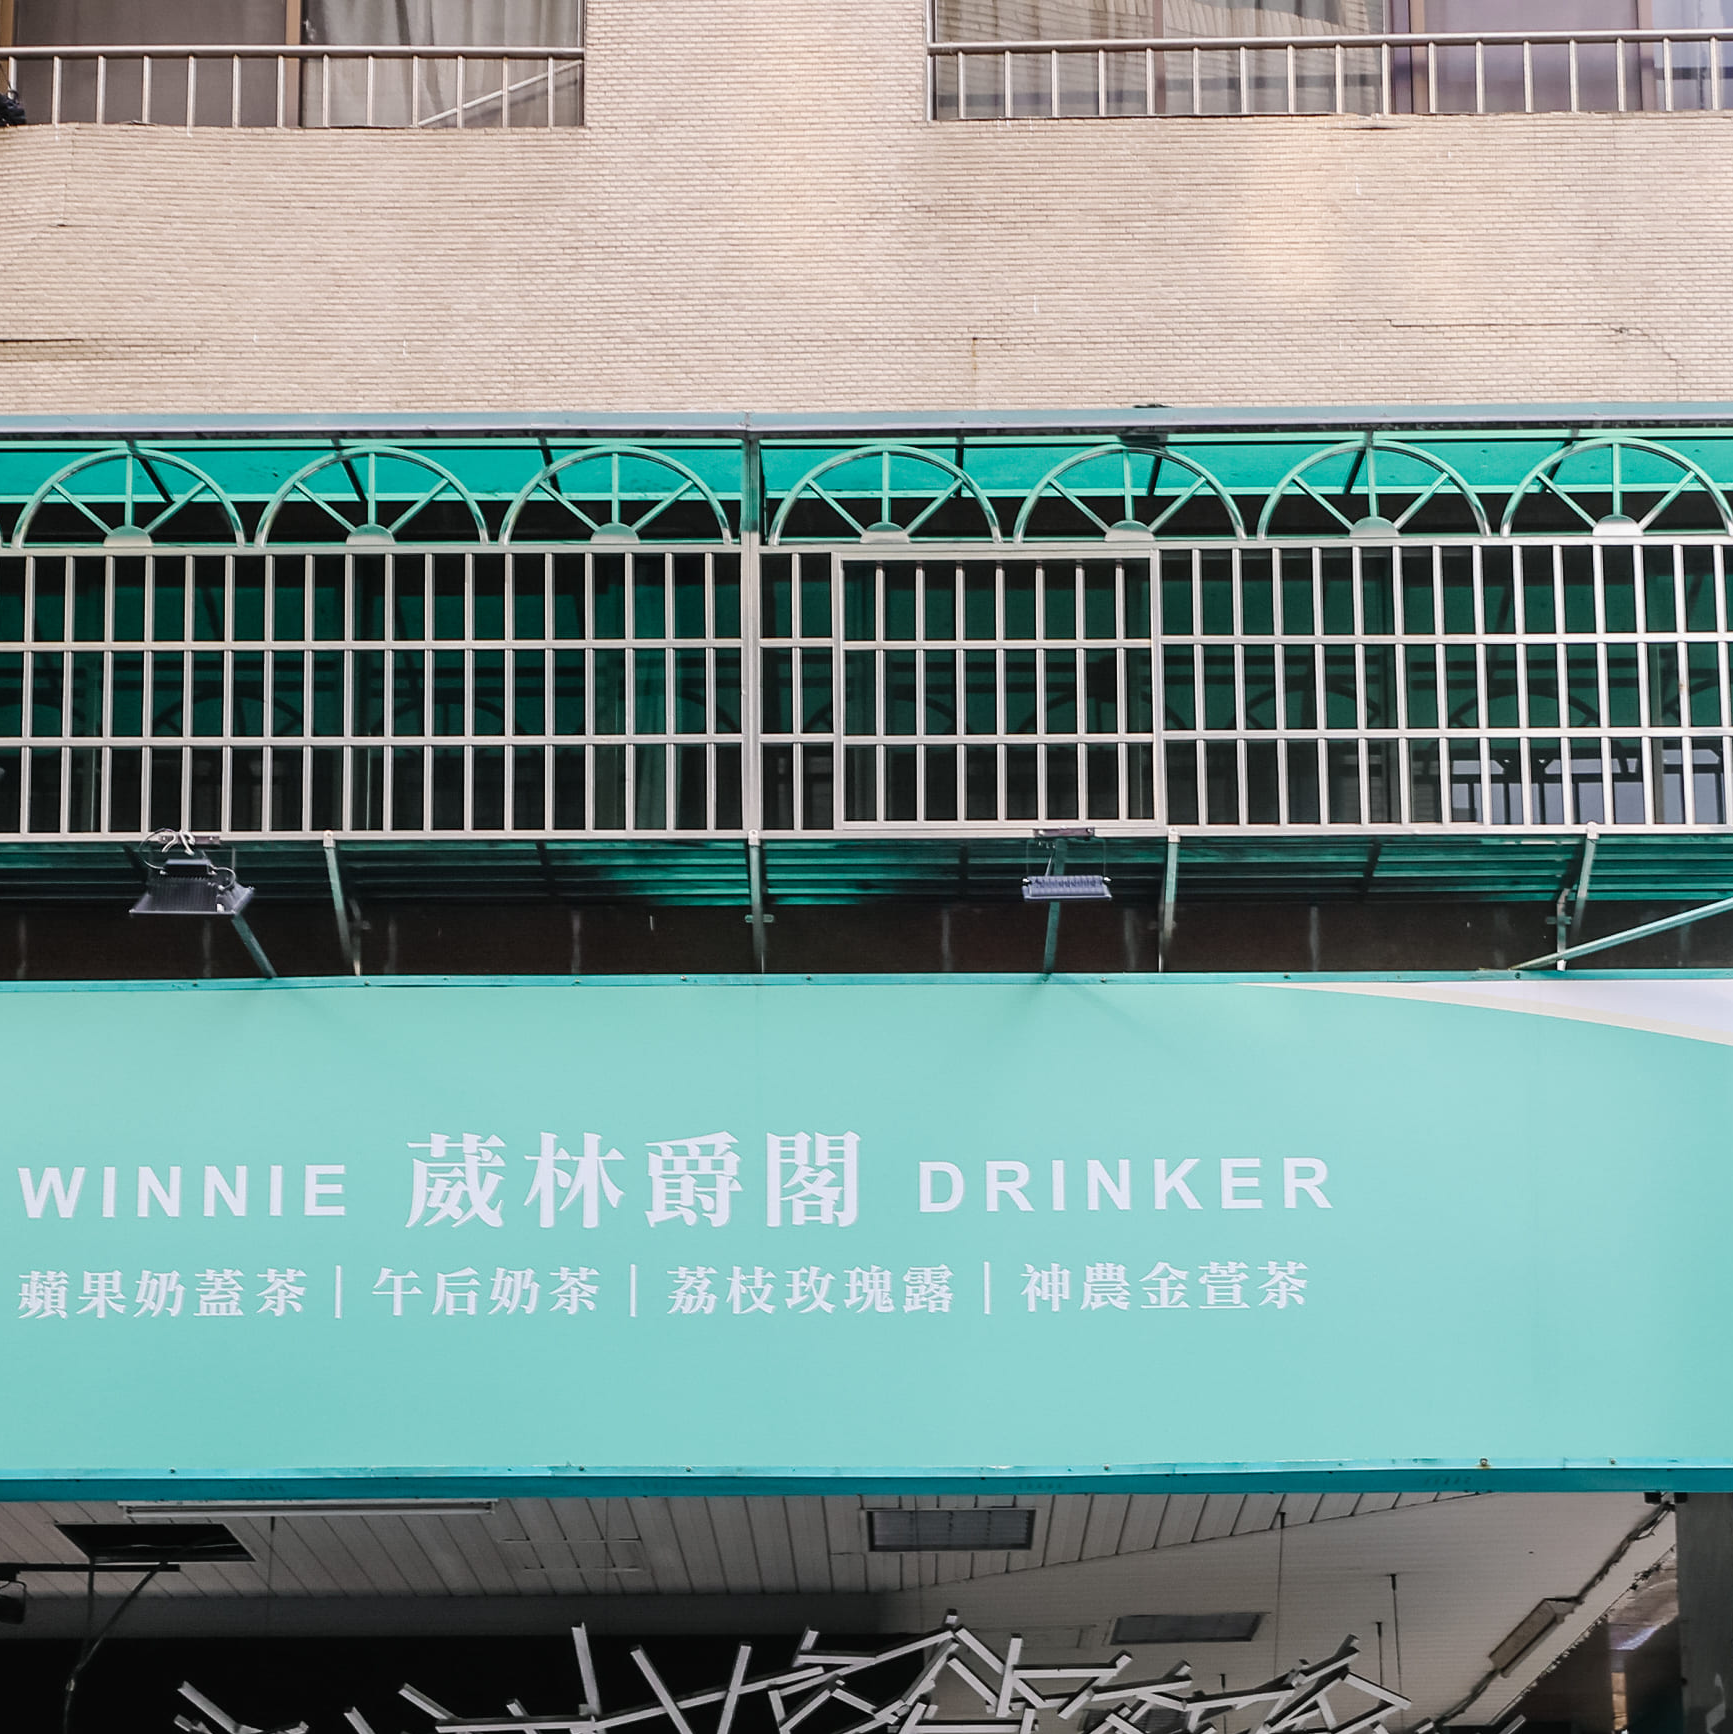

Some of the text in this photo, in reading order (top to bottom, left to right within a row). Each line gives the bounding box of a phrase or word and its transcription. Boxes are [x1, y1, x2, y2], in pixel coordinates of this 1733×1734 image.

[18, 1164, 347, 1219] WINNIE
[404, 1132, 860, 1230] 葳林爵閣
[918, 1156, 1333, 1214] DRINKER
[17, 1261, 1309, 1320] 蘋果奶蓋茶 午后奶茶 荔枝玫瑰露 神農金萱茶
